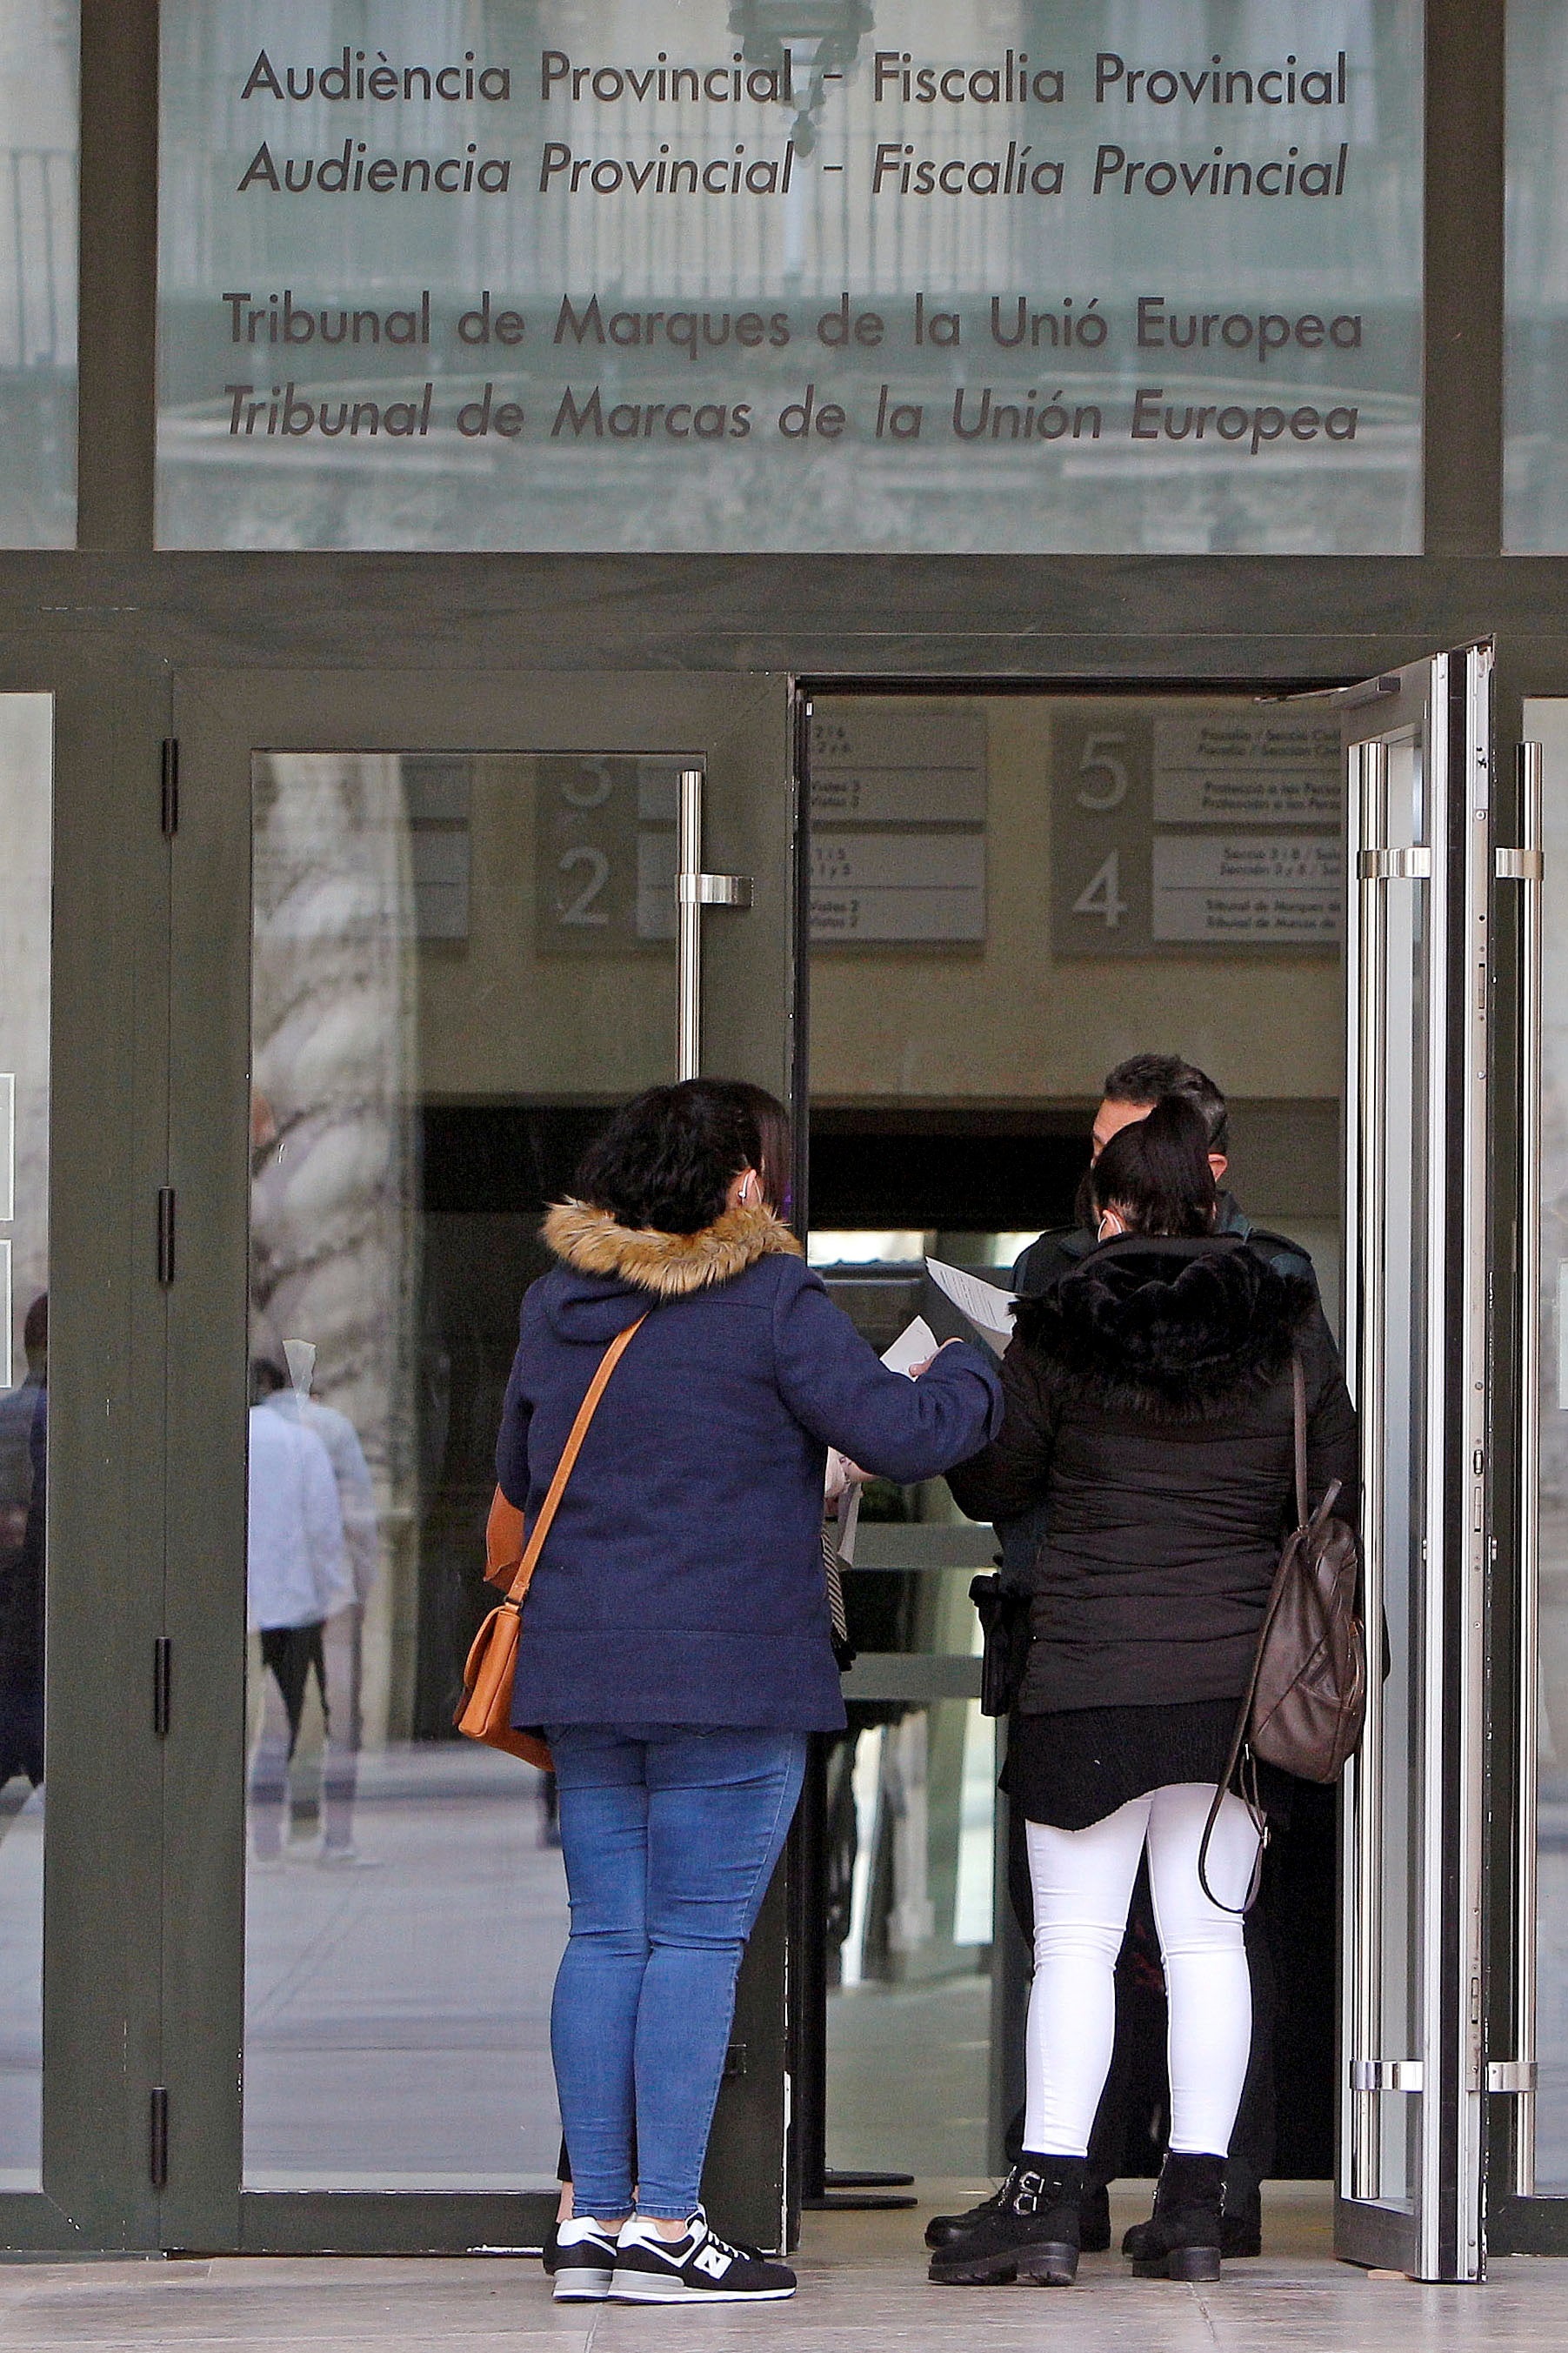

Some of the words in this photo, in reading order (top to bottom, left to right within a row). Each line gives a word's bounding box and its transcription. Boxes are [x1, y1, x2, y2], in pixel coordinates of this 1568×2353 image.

[241, 46, 510, 103] Audiència
[542, 49, 792, 103] Provincial
[873, 50, 1064, 104] Fiscalia
[1096, 52, 1345, 104] Provincial
[237, 138, 510, 193] Audiencia
[538, 142, 794, 194] Provincial
[871, 142, 1064, 195] Fiscalía
[1092, 143, 1348, 196] Provincial
[223, 290, 430, 345] Tribunal
[457, 291, 525, 346] de
[553, 293, 791, 360] Marques
[817, 292, 884, 347] de
[915, 292, 960, 347] la
[991, 296, 1108, 348] Unió
[1137, 297, 1362, 362] Europea
[224, 382, 432, 437] Tribunal
[457, 383, 524, 438] de
[550, 385, 751, 438] Marcas
[778, 384, 846, 439] de
[875, 384, 922, 438] la
[952, 388, 1102, 440] Unión
[1131, 389, 1358, 455] Europea
[1078, 732, 1129, 810] 5
[559, 847, 612, 924] 2
[1072, 849, 1130, 928] 4
